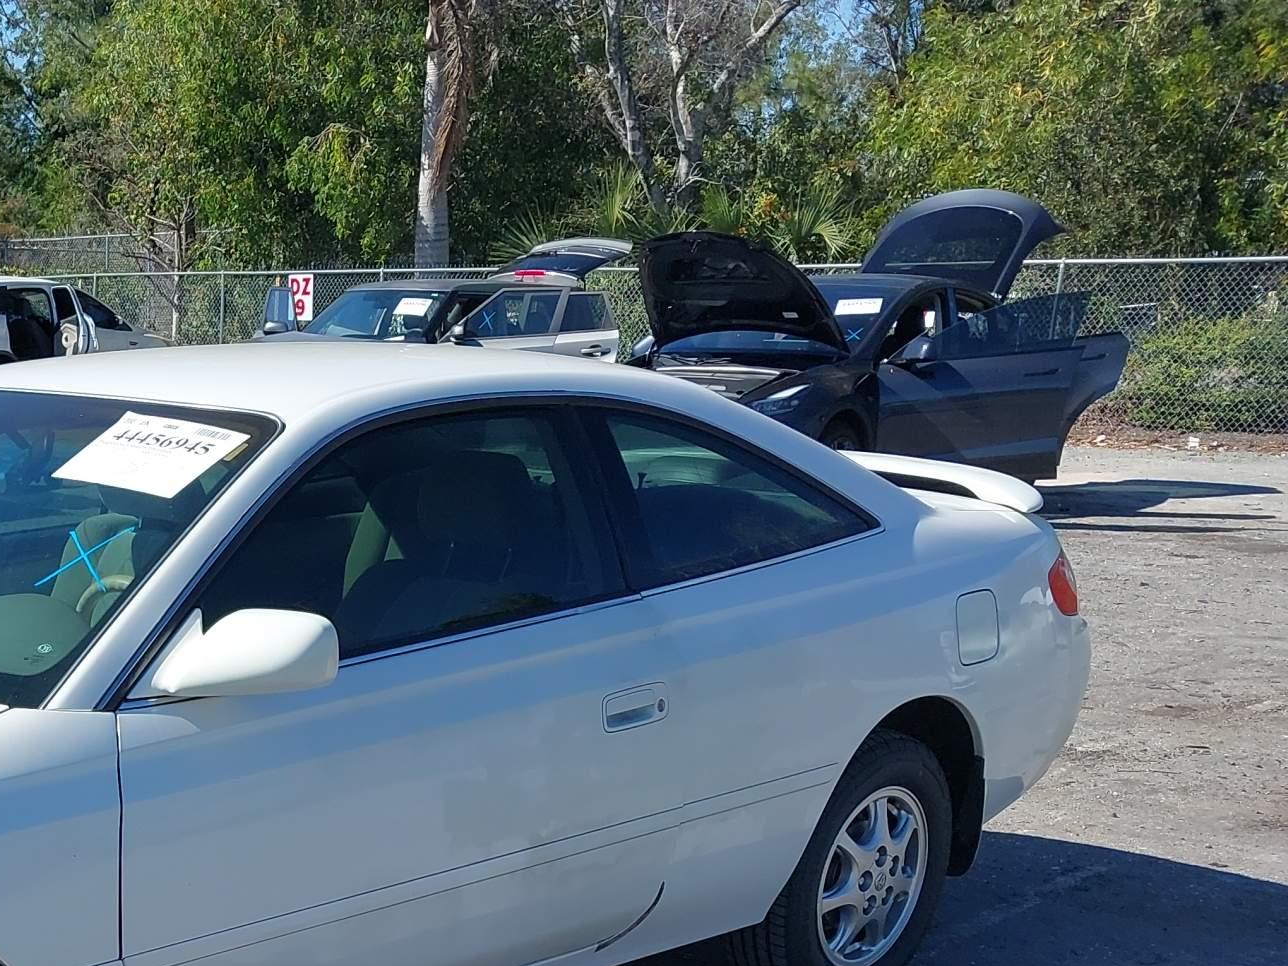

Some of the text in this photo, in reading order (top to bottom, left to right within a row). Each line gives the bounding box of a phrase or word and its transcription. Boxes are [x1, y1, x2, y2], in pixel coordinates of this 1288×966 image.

[290, 277, 312, 297] DZ
[295, 298, 306, 317] 9
[112, 429, 217, 456] 44456945
